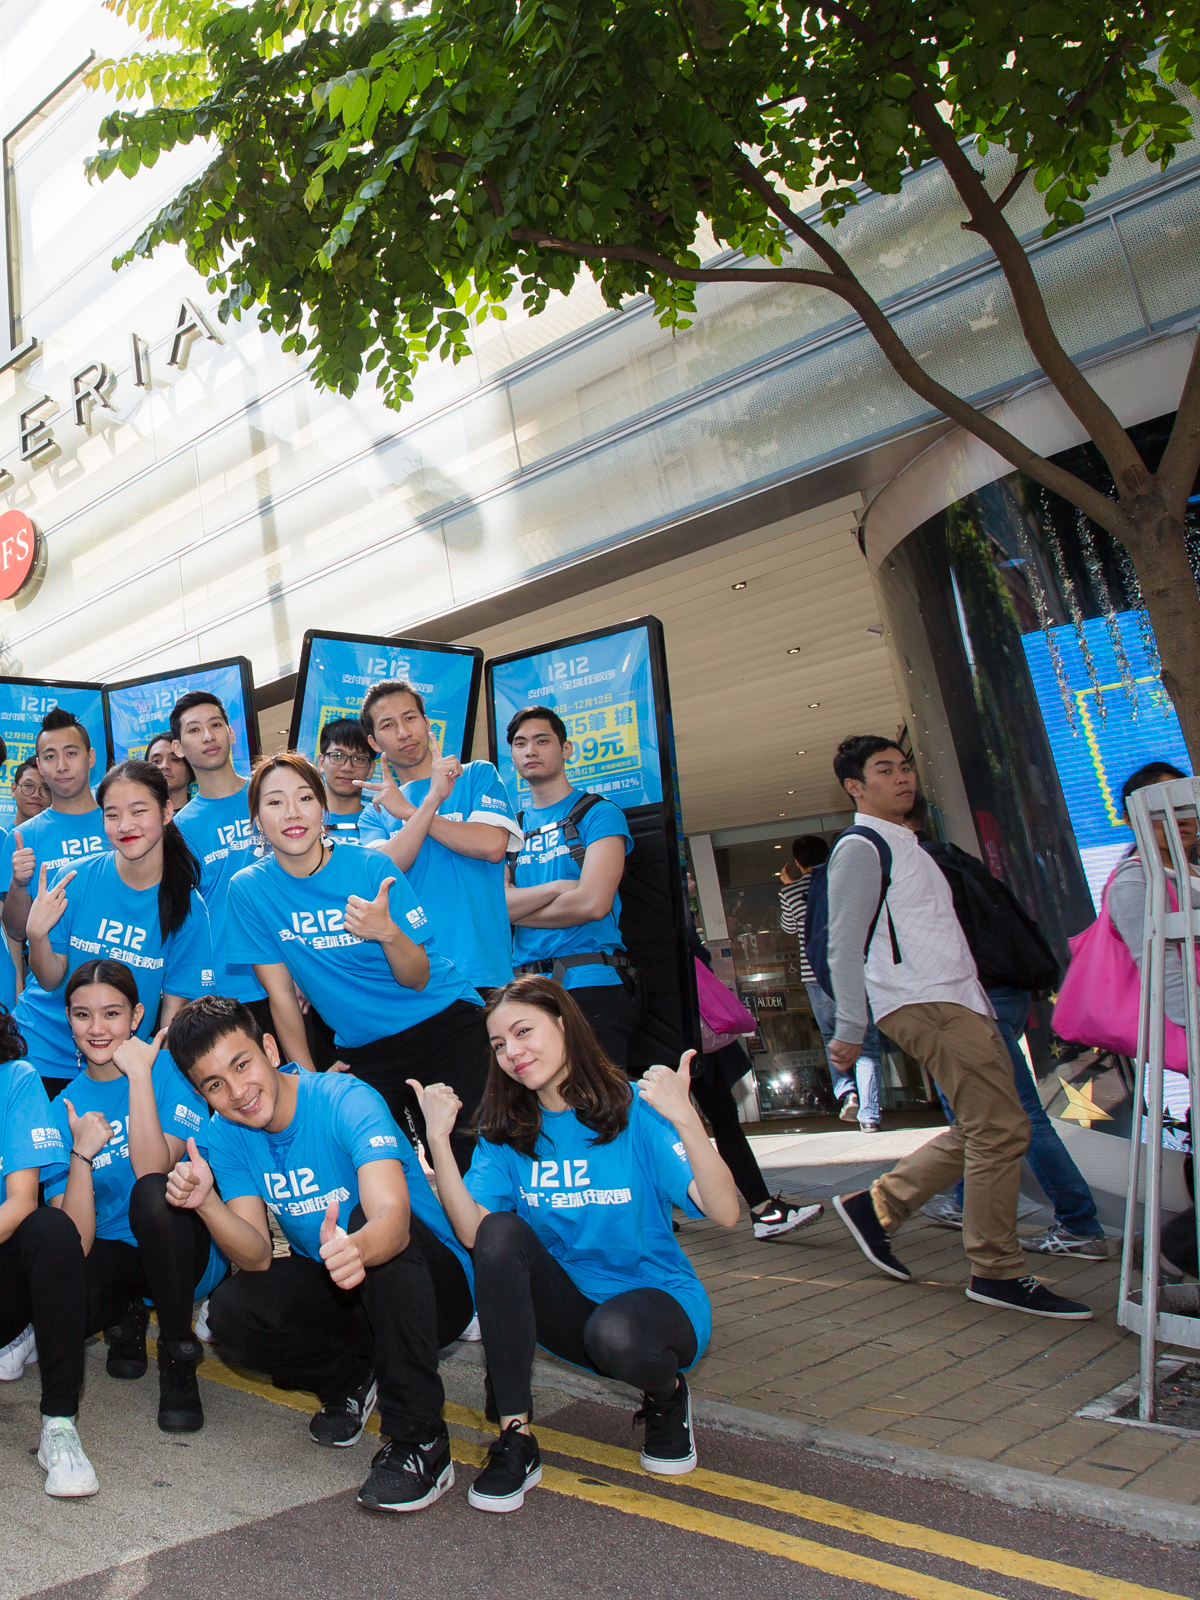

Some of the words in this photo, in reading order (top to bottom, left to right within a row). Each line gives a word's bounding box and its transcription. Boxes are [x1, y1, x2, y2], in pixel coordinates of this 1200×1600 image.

[548, 656, 590, 681] 1212
[61, 836, 103, 855] 1212
[525, 829, 560, 852] 1212
[291, 908, 345, 933] 1212
[97, 918, 147, 951] 1212
[263, 1167, 320, 1199] 1212
[531, 1159, 591, 1188] 1212
